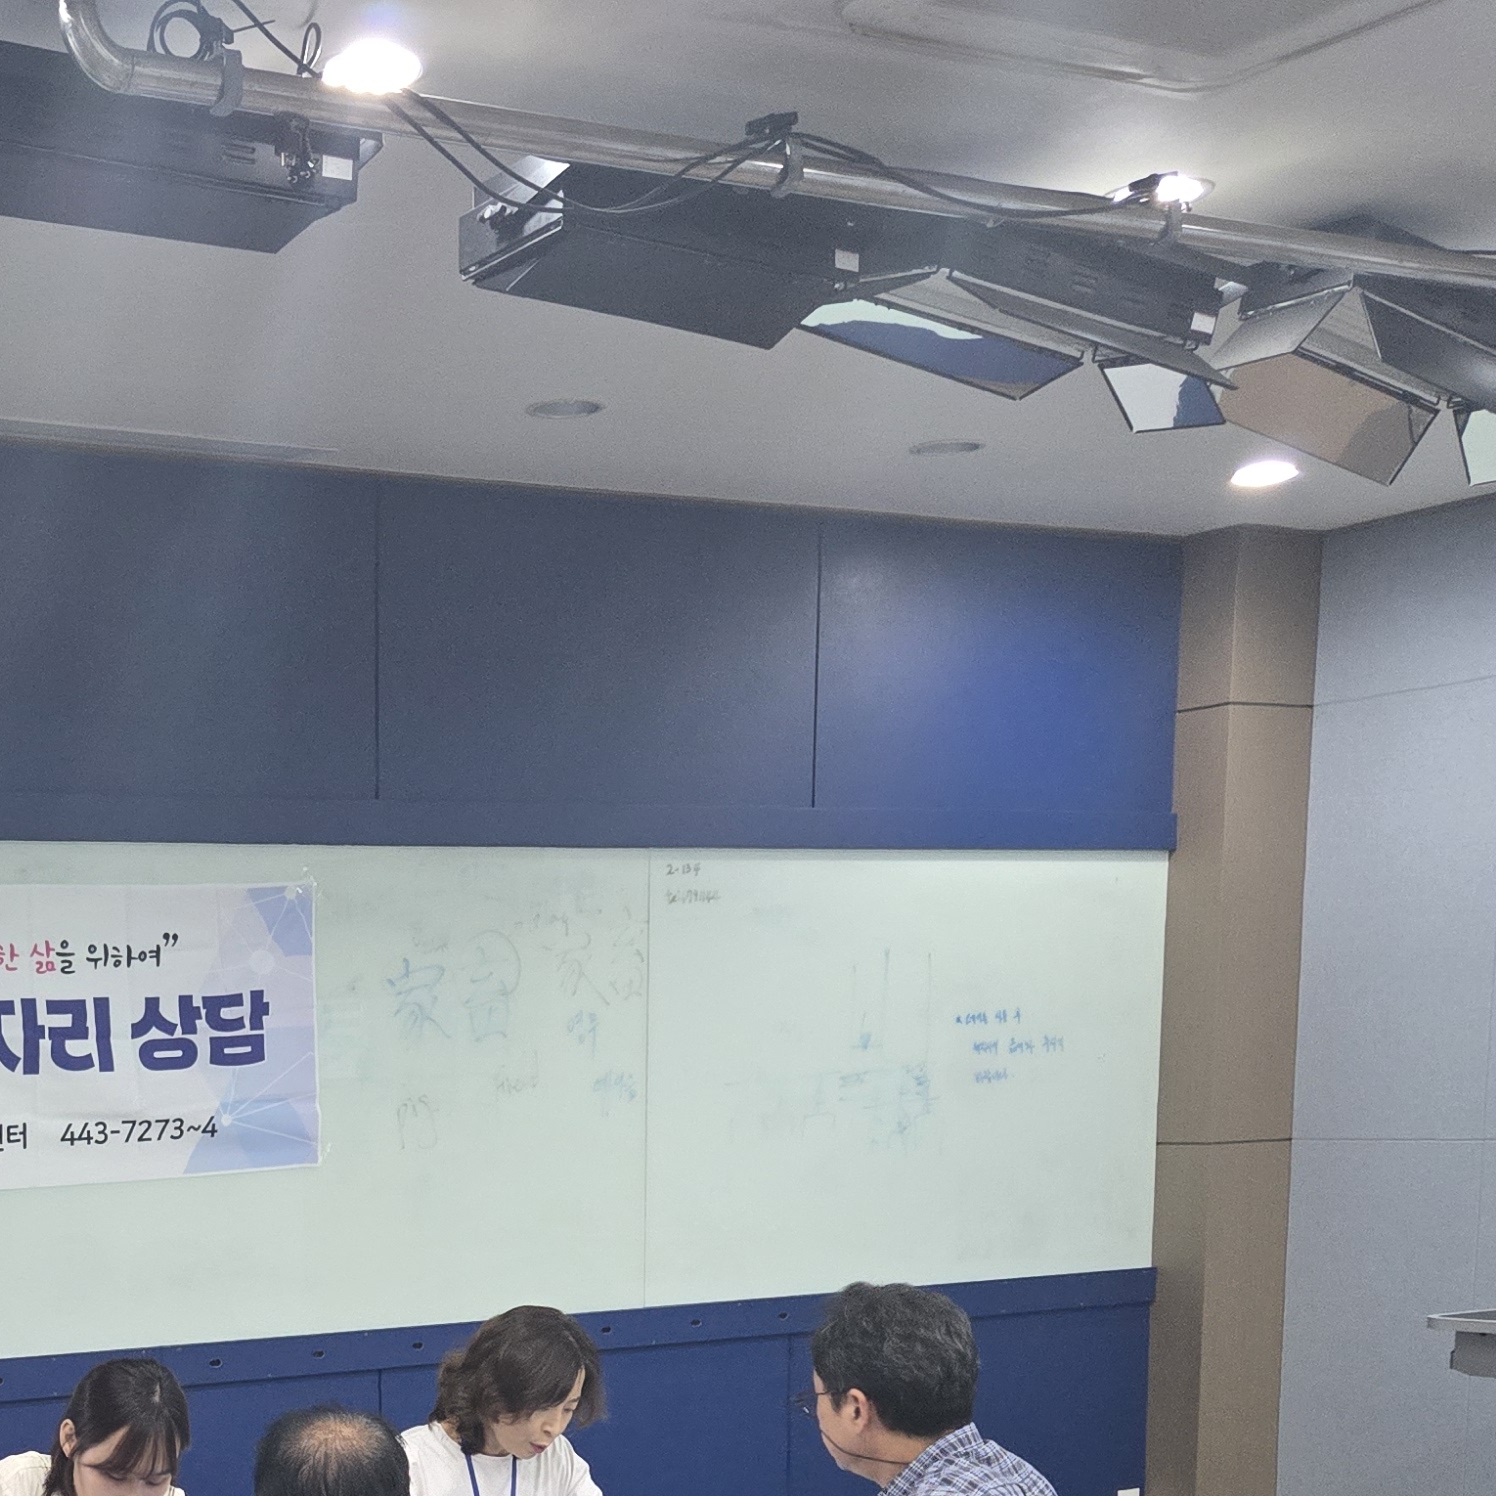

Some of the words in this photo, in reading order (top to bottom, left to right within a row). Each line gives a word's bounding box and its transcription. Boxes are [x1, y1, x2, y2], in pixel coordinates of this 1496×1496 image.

[29, 939, 76, 975] 삶을
[85, 932, 179, 970] 위하여”
[130, 989, 270, 1071] 상담
[59, 1116, 219, 1147] 443-7273~4
